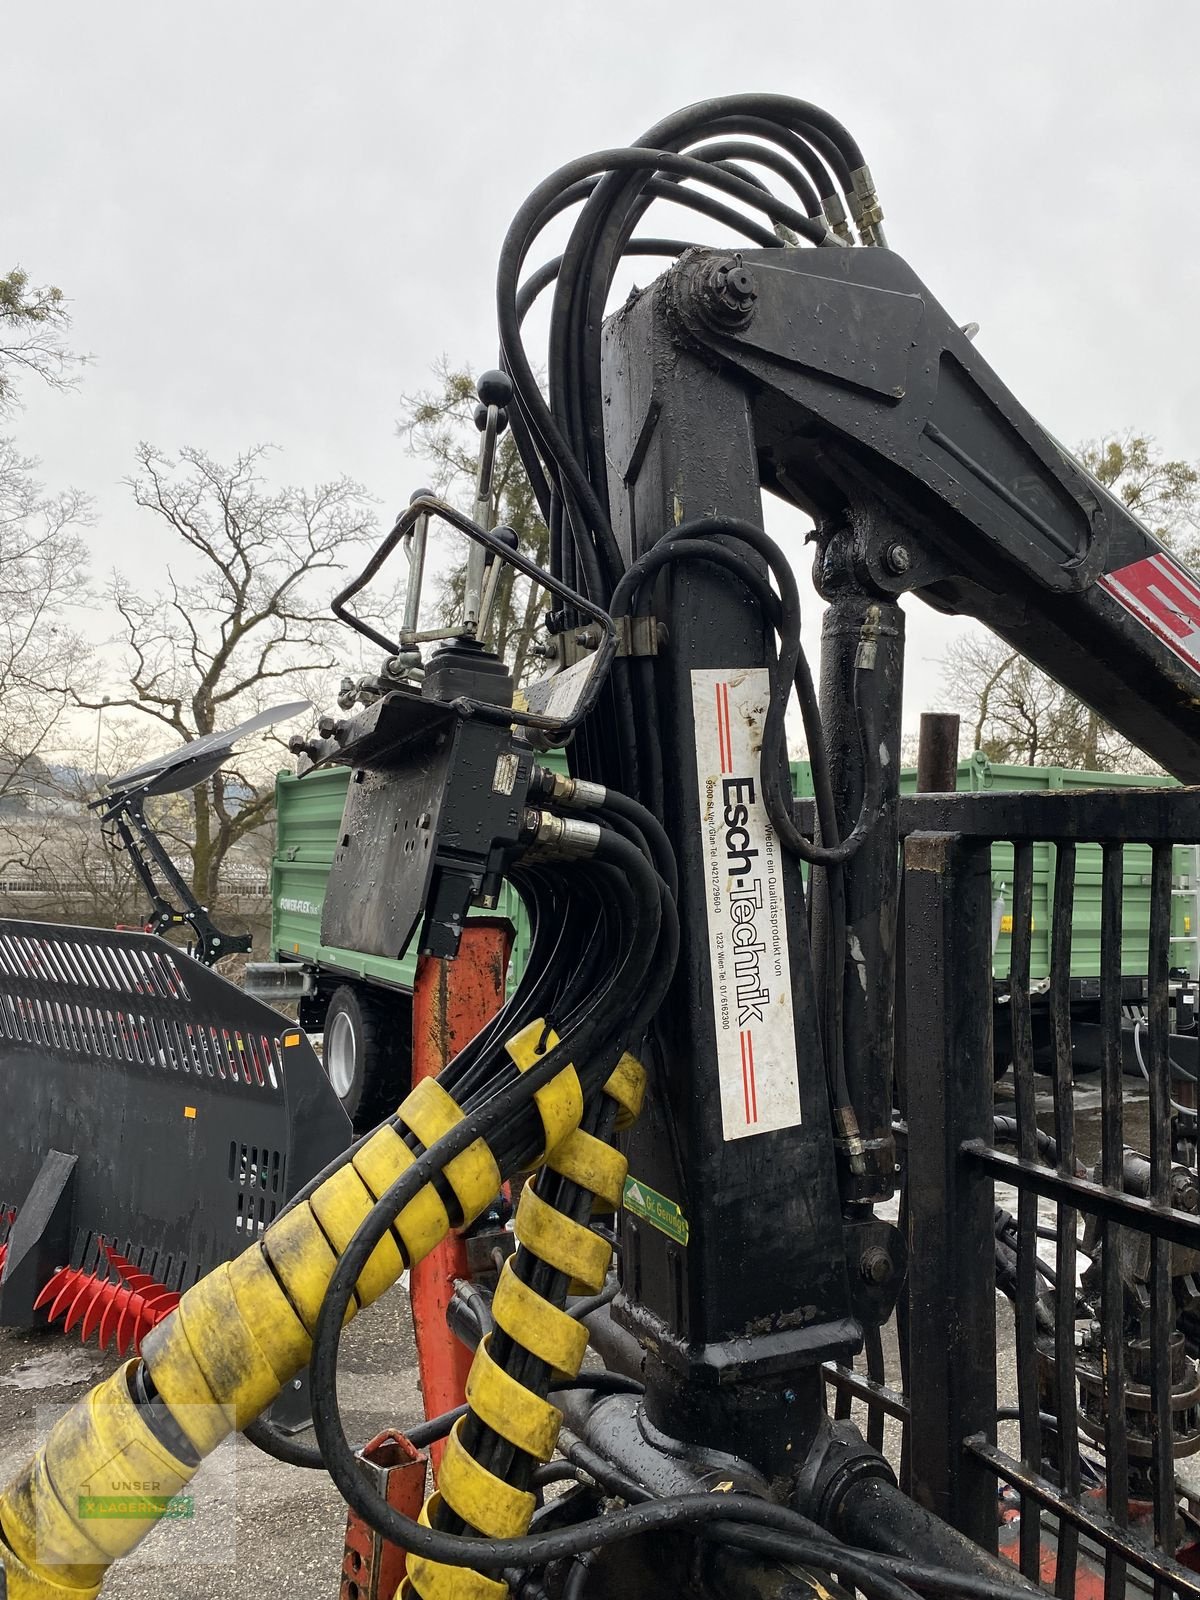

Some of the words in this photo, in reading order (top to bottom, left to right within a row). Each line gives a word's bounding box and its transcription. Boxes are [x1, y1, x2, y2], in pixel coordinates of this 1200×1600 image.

[705, 780, 714, 799] 9300
[763, 823, 774, 857] Wieder
[766, 860, 775, 874] ein
[768, 877, 782, 956] Qualitätsprodukt
[716, 932, 724, 949] 1232
[774, 959, 782, 976] von
[719, 985, 729, 1029] 01/6162300
